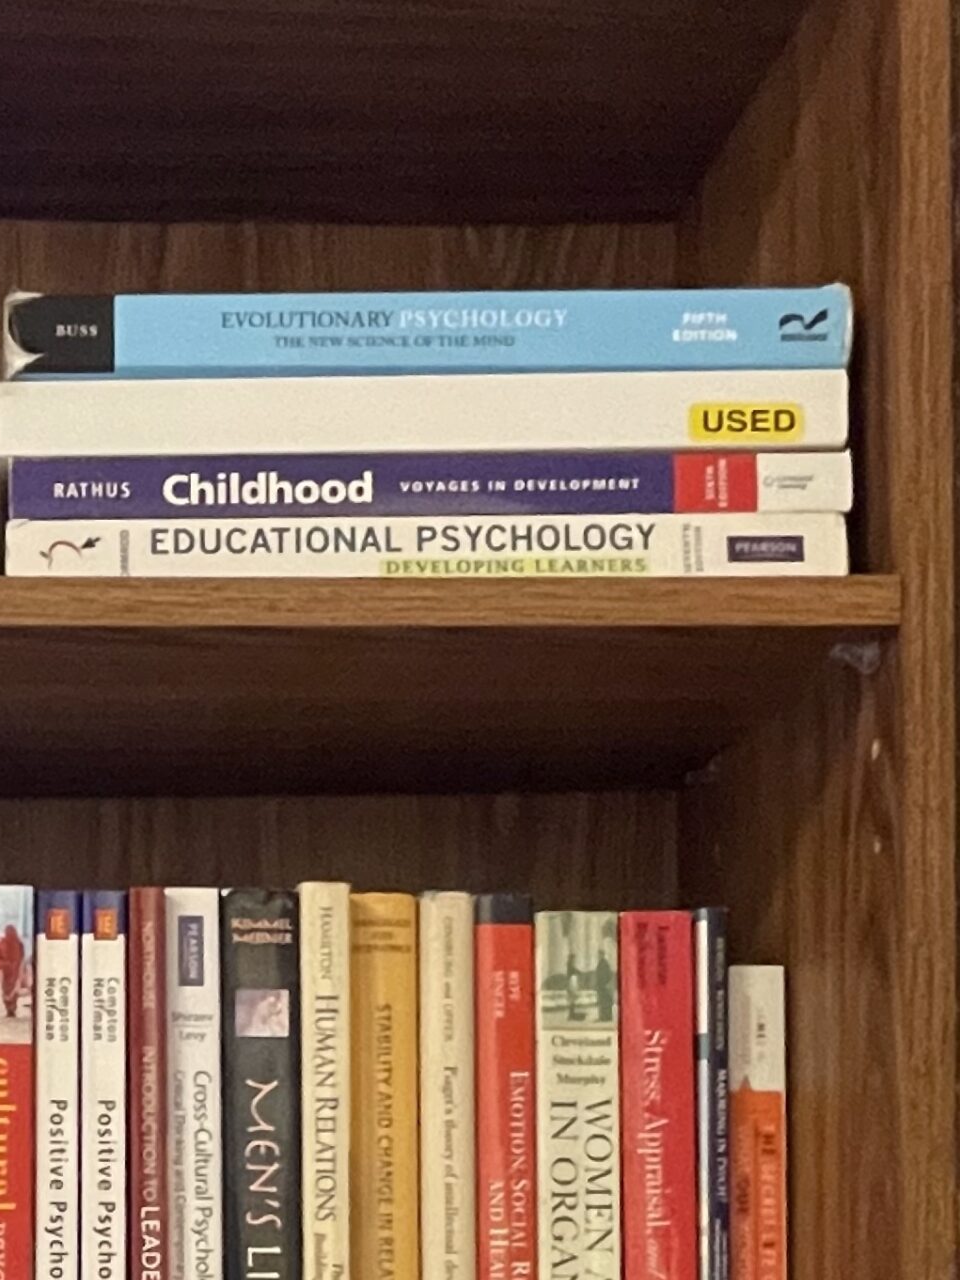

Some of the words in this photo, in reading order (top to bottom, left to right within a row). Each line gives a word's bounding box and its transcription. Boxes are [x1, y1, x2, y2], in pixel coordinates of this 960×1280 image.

[55, 324, 97, 337] BUSS
[221, 310, 393, 329] EVOLUTIONARY
[399, 308, 567, 329] PSYCHOLOGY
[672, 328, 738, 343] EDITION
[682, 311, 728, 326] FIFTH
[274, 335, 302, 349] THE
[308, 335, 343, 348] NEW
[347, 335, 409, 348] SCIENCE
[414, 334, 436, 348] OF
[438, 334, 469, 347] THE
[473, 333, 516, 347] MIND
[702, 408, 797, 433] USED
[53, 482, 131, 499] RATHUS
[163, 471, 373, 505] Childhood
[400, 478, 480, 493] VOYAGES
[487, 479, 506, 491] IN
[514, 477, 640, 492] DEVELOPMENT
[151, 526, 402, 555] EDUCATIONAL
[417, 523, 656, 552] PSYCHOLOGY
[734, 541, 798, 554] PEARSON
[385, 559, 526, 575] DEVELOPING
[534, 557, 647, 574] LEARNERS
[188, 923, 200, 979] PEARSON
[44, 977, 58, 1041] Hoffman
[56, 976, 71, 1042] Compton
[92, 977, 107, 1041] Hoffman
[104, 976, 119, 1043] Compton
[179, 1030, 207, 1042] Levy
[314, 994, 340, 1087] HUMAN
[376, 1003, 393, 1086] STABILITY
[551, 1035, 612, 1047] Cleveland
[551, 1055, 612, 1066] Stockdale
[555, 1072, 606, 1086] Murphy
[173, 1069, 187, 1111] Critical
[378, 1092, 392, 1129] AND
[172, 1114, 187, 1165] Thinking
[191, 1069, 214, 1200] Cross-Cultural
[549, 1100, 579, 1141] IN
[49, 1099, 68, 1191] Positive
[97, 1099, 117, 1192] Positive
[243, 1078, 283, 1229] MEN'S
[314, 1095, 339, 1222] RELATIONS
[174, 1169, 187, 1192] and
[378, 1135, 393, 1203] CHANGE
[584, 1098, 615, 1253] WOMEN
[488, 1179, 504, 1222] AND
[510, 1178, 530, 1250] SOCIAL
[173, 1195, 188, 1280] Contemporary
[379, 1212, 393, 1231] IN
